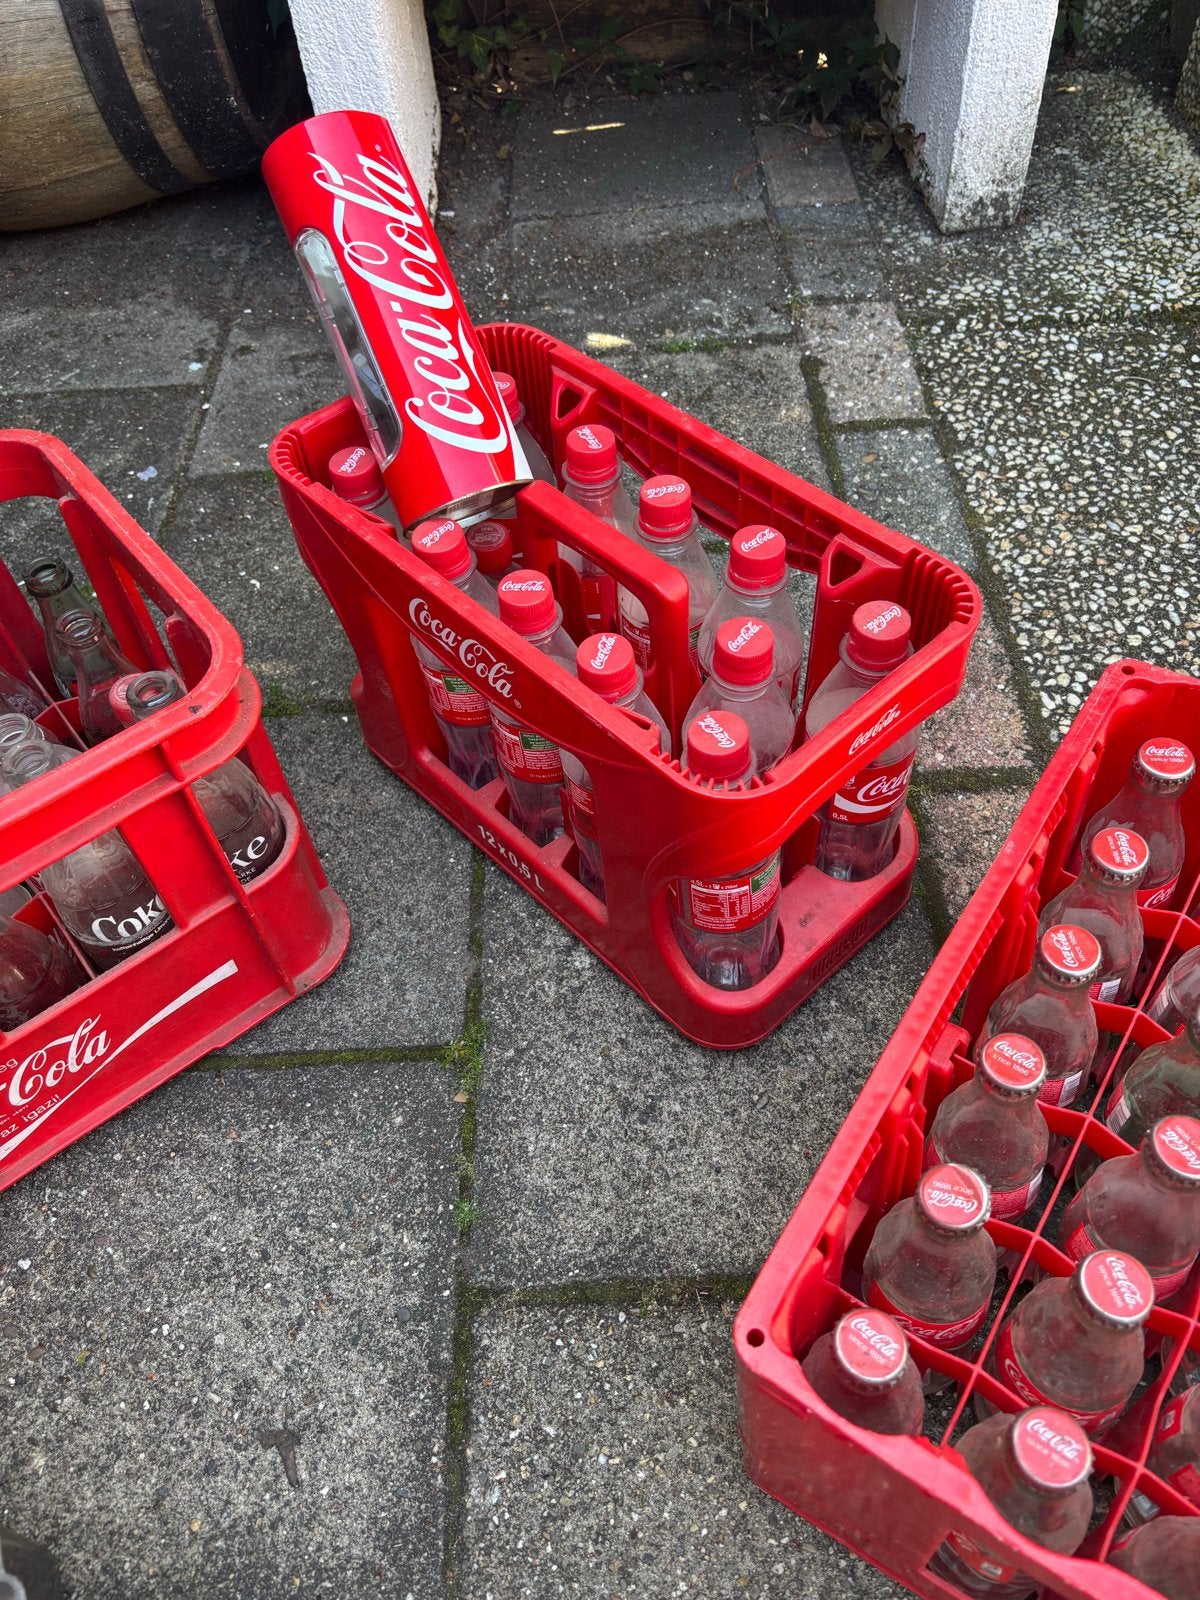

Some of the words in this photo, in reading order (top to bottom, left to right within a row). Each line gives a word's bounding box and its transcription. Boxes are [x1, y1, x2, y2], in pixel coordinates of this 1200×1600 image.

[306, 144, 509, 454] Coca-Cola
[575, 426, 603, 450] Coca-Cola
[338, 447, 366, 473] Coca-Cola
[642, 483, 686, 499] Coca-Cola
[418, 520, 455, 548] Coca-Cola
[740, 527, 779, 553] Coca-Cola
[501, 580, 546, 592] Coca-Cola
[863, 605, 901, 634] Coca-Cola
[408, 597, 516, 700] Coca-Cola
[590, 634, 617, 670] Coca-Cola
[727, 620, 763, 652] Coca-Cola
[697, 714, 736, 749] Coca-Cola
[848, 703, 900, 755] Coca-Cola
[1145, 745, 1188, 757] Coca-Cola
[1114, 831, 1139, 866] Coca-Cola
[1050, 929, 1079, 967] Coca-Cola
[993, 1040, 1039, 1071] Coca-Cola
[927, 1188, 978, 1213] Coca-Cola
[1105, 1256, 1145, 1310] Coca-Cola
[851, 1317, 901, 1361] Coca-Cola
[1026, 1418, 1082, 1464] Coca-Cola
